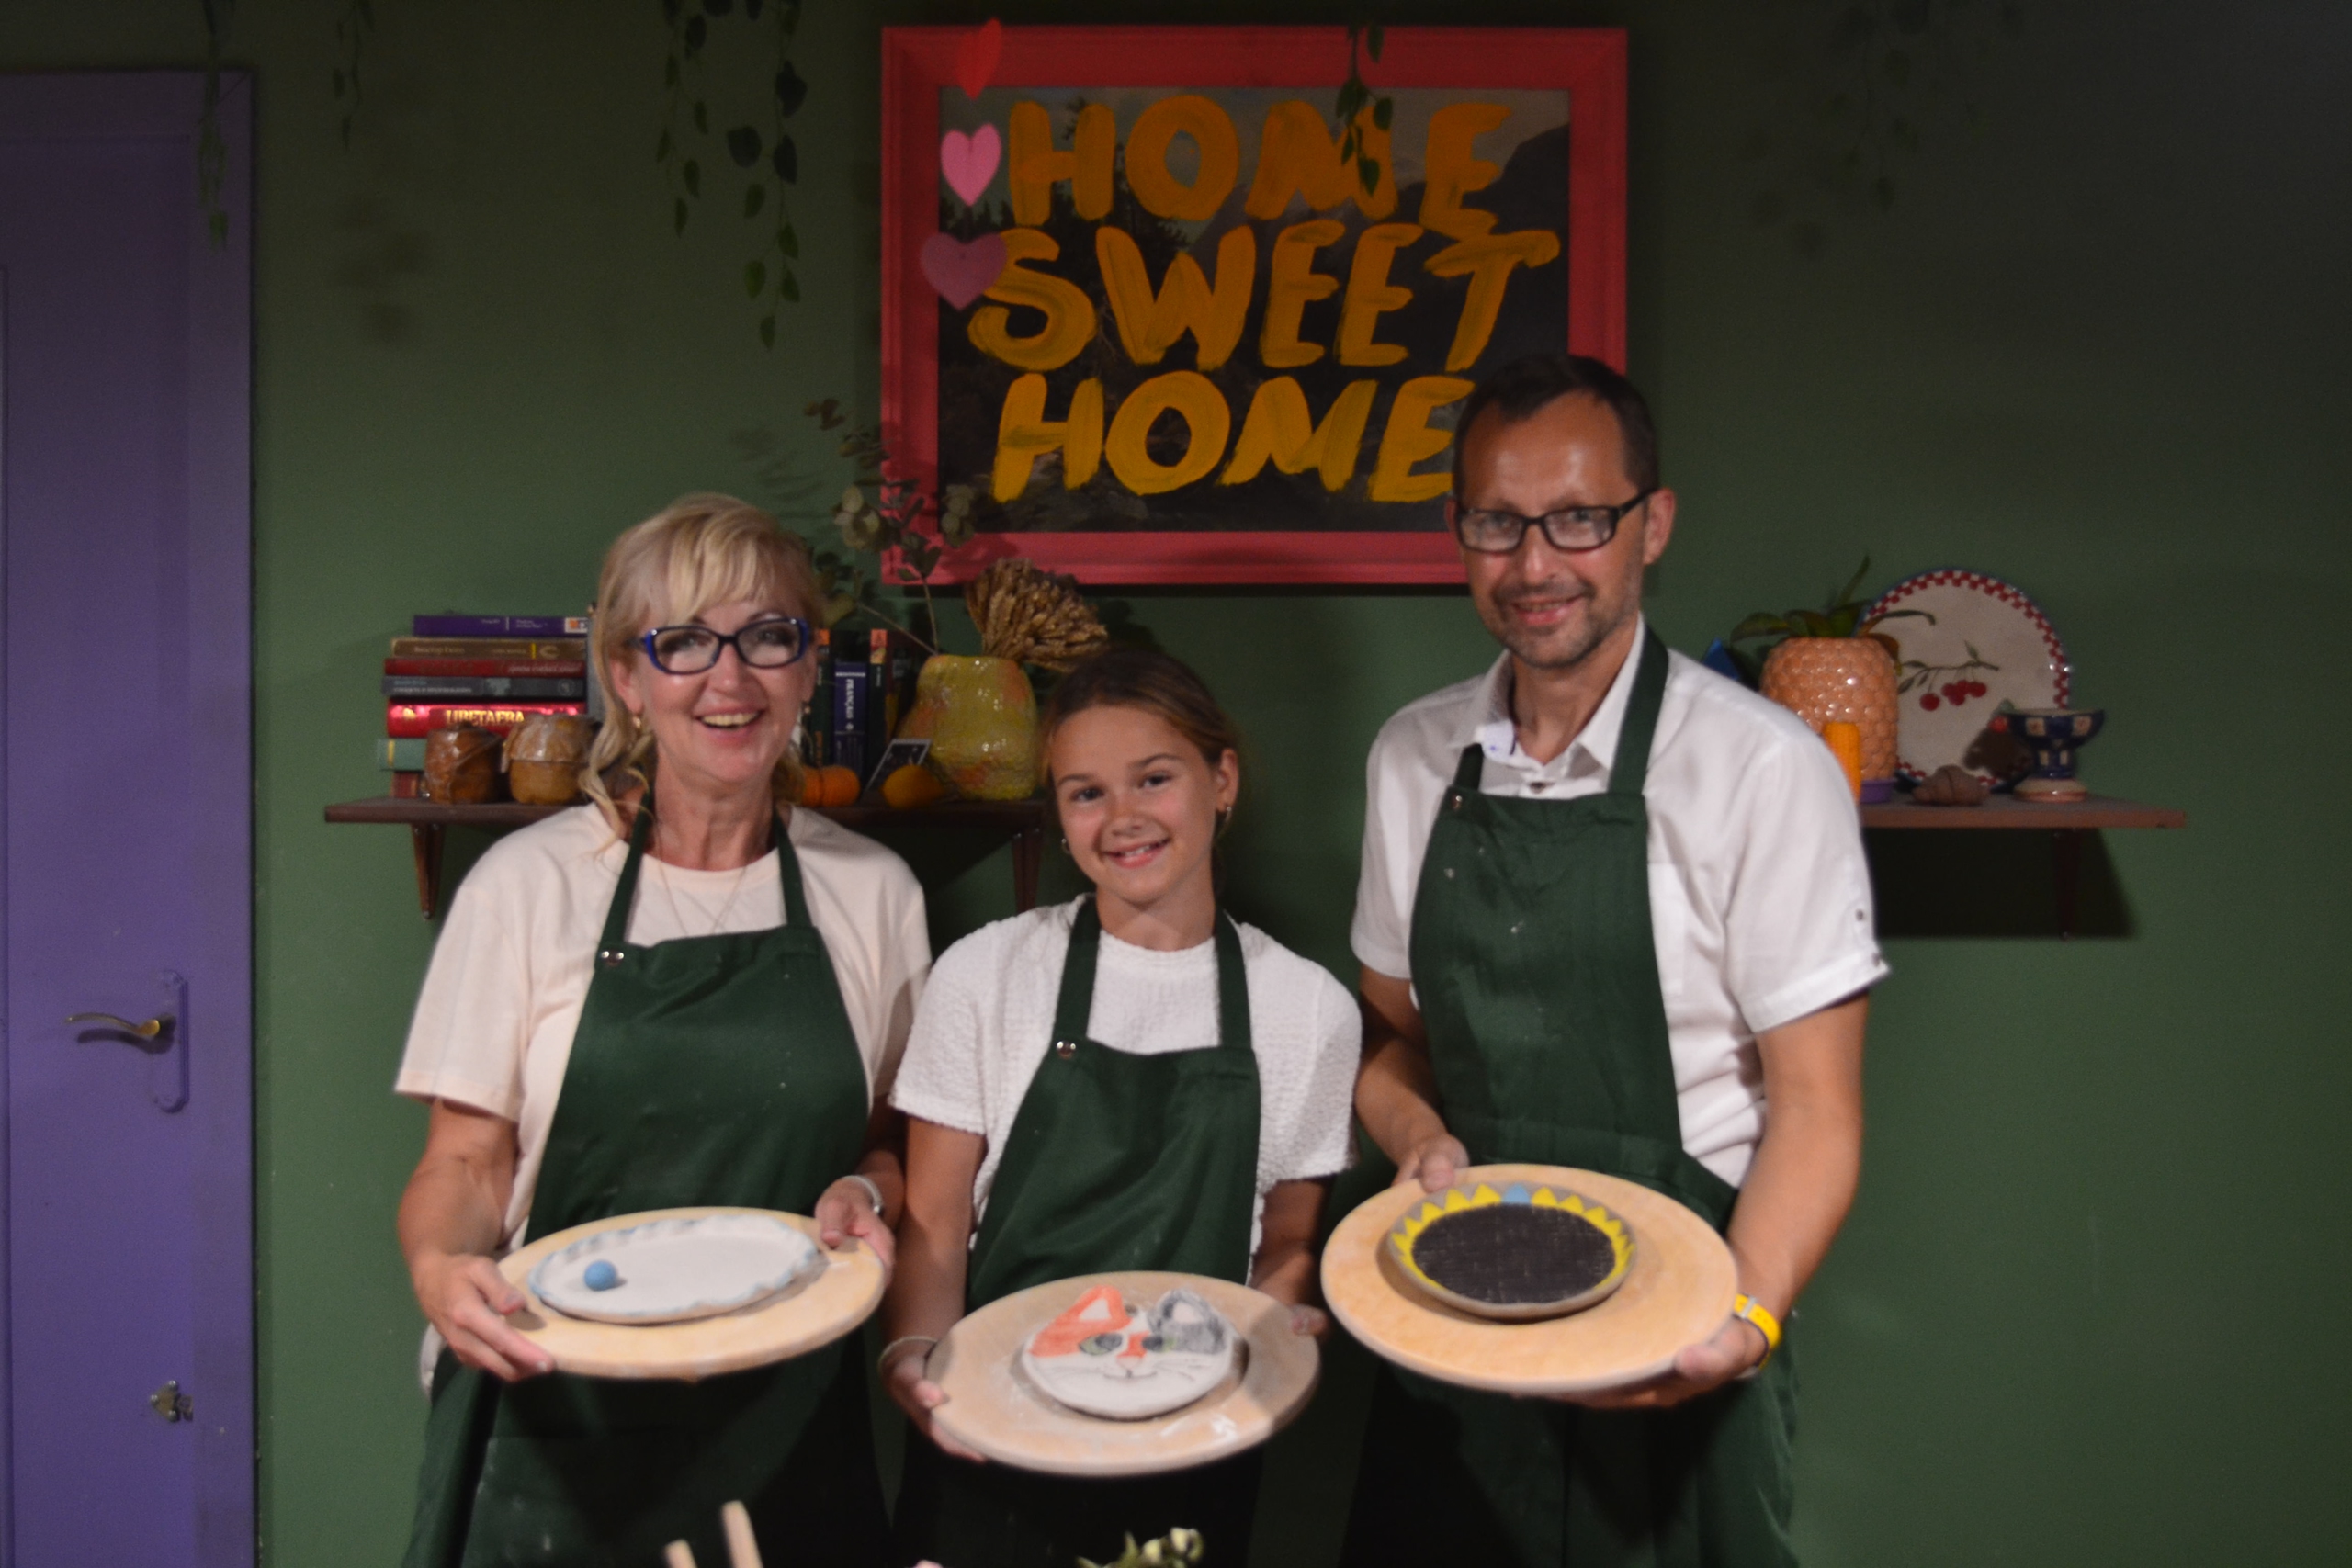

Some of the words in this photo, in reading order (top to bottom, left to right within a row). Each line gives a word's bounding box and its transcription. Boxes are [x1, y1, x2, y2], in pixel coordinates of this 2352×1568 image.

[1008, 95, 1512, 240] HOME
[967, 219, 1560, 371] SWEET
[992, 370, 1475, 502] HOME
